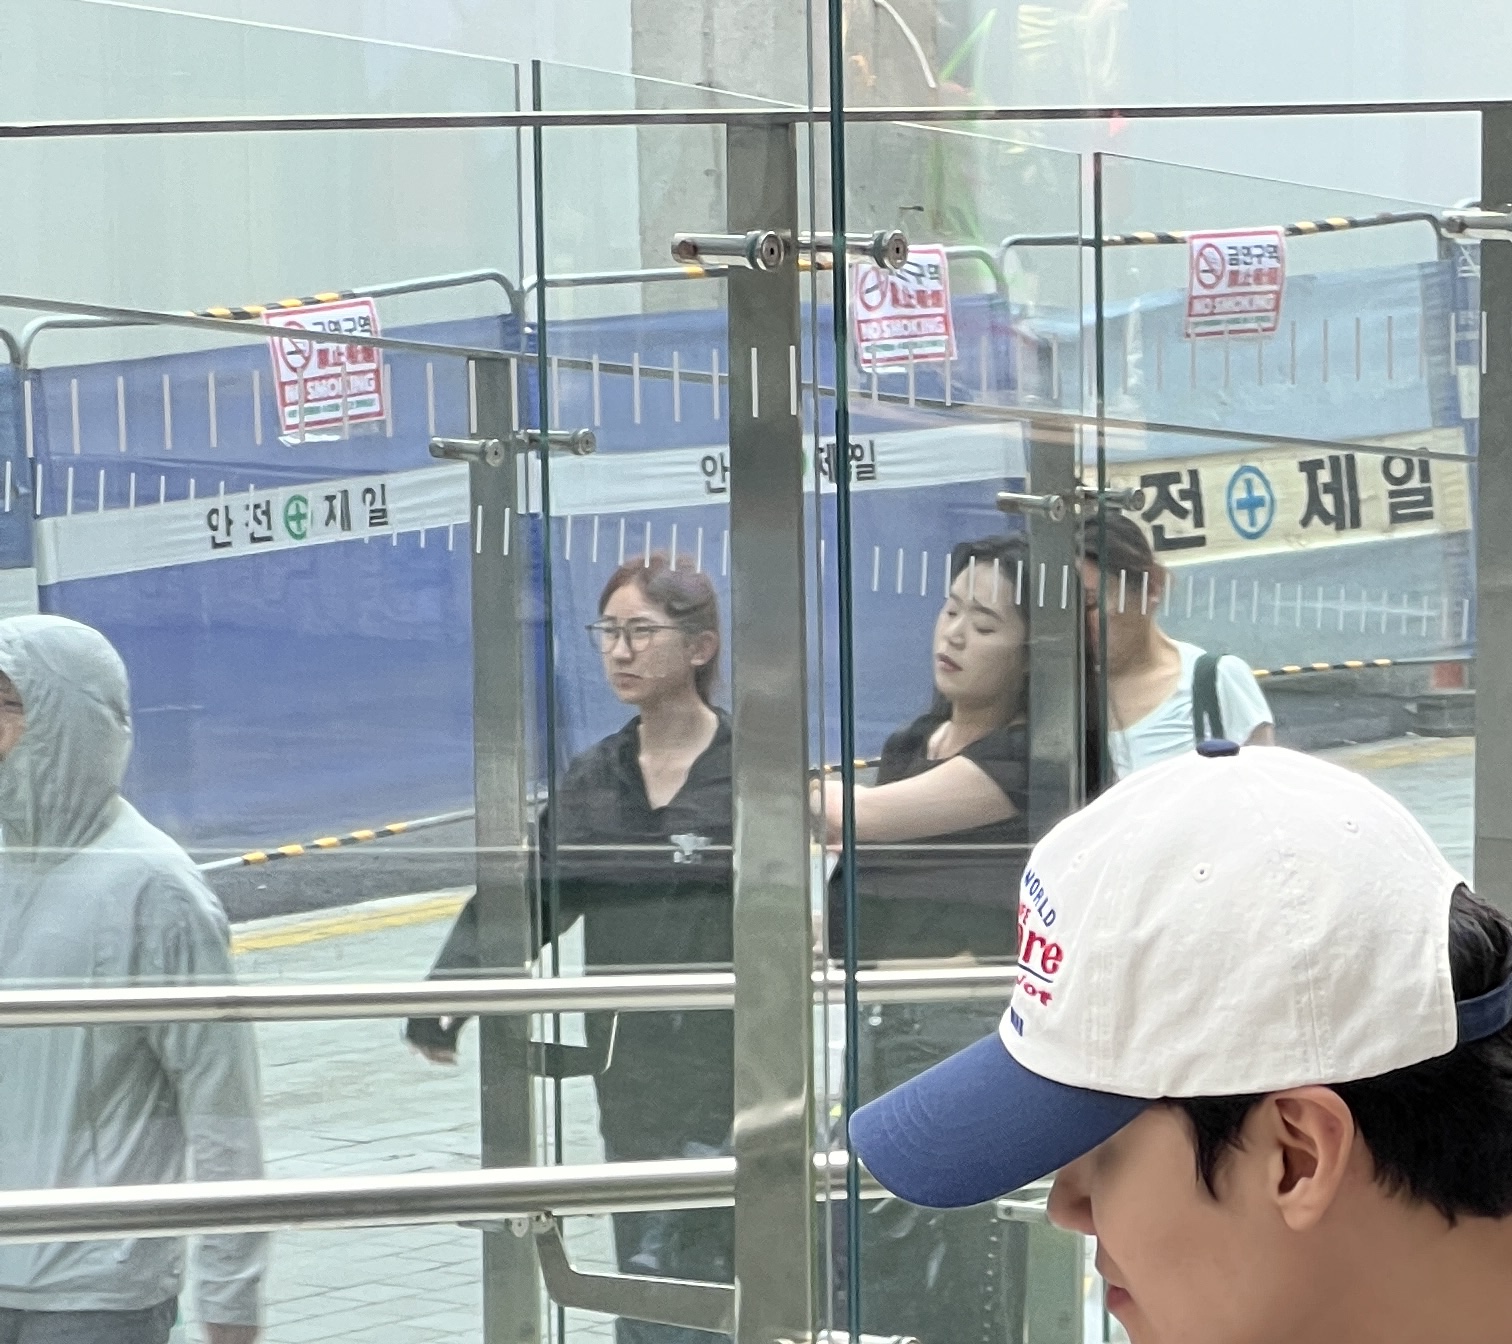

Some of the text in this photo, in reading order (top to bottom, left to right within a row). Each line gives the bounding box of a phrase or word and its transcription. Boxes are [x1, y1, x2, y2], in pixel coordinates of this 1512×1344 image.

[206, 483, 389, 550] 안전 제일
[1299, 450, 1434, 531] 제일
